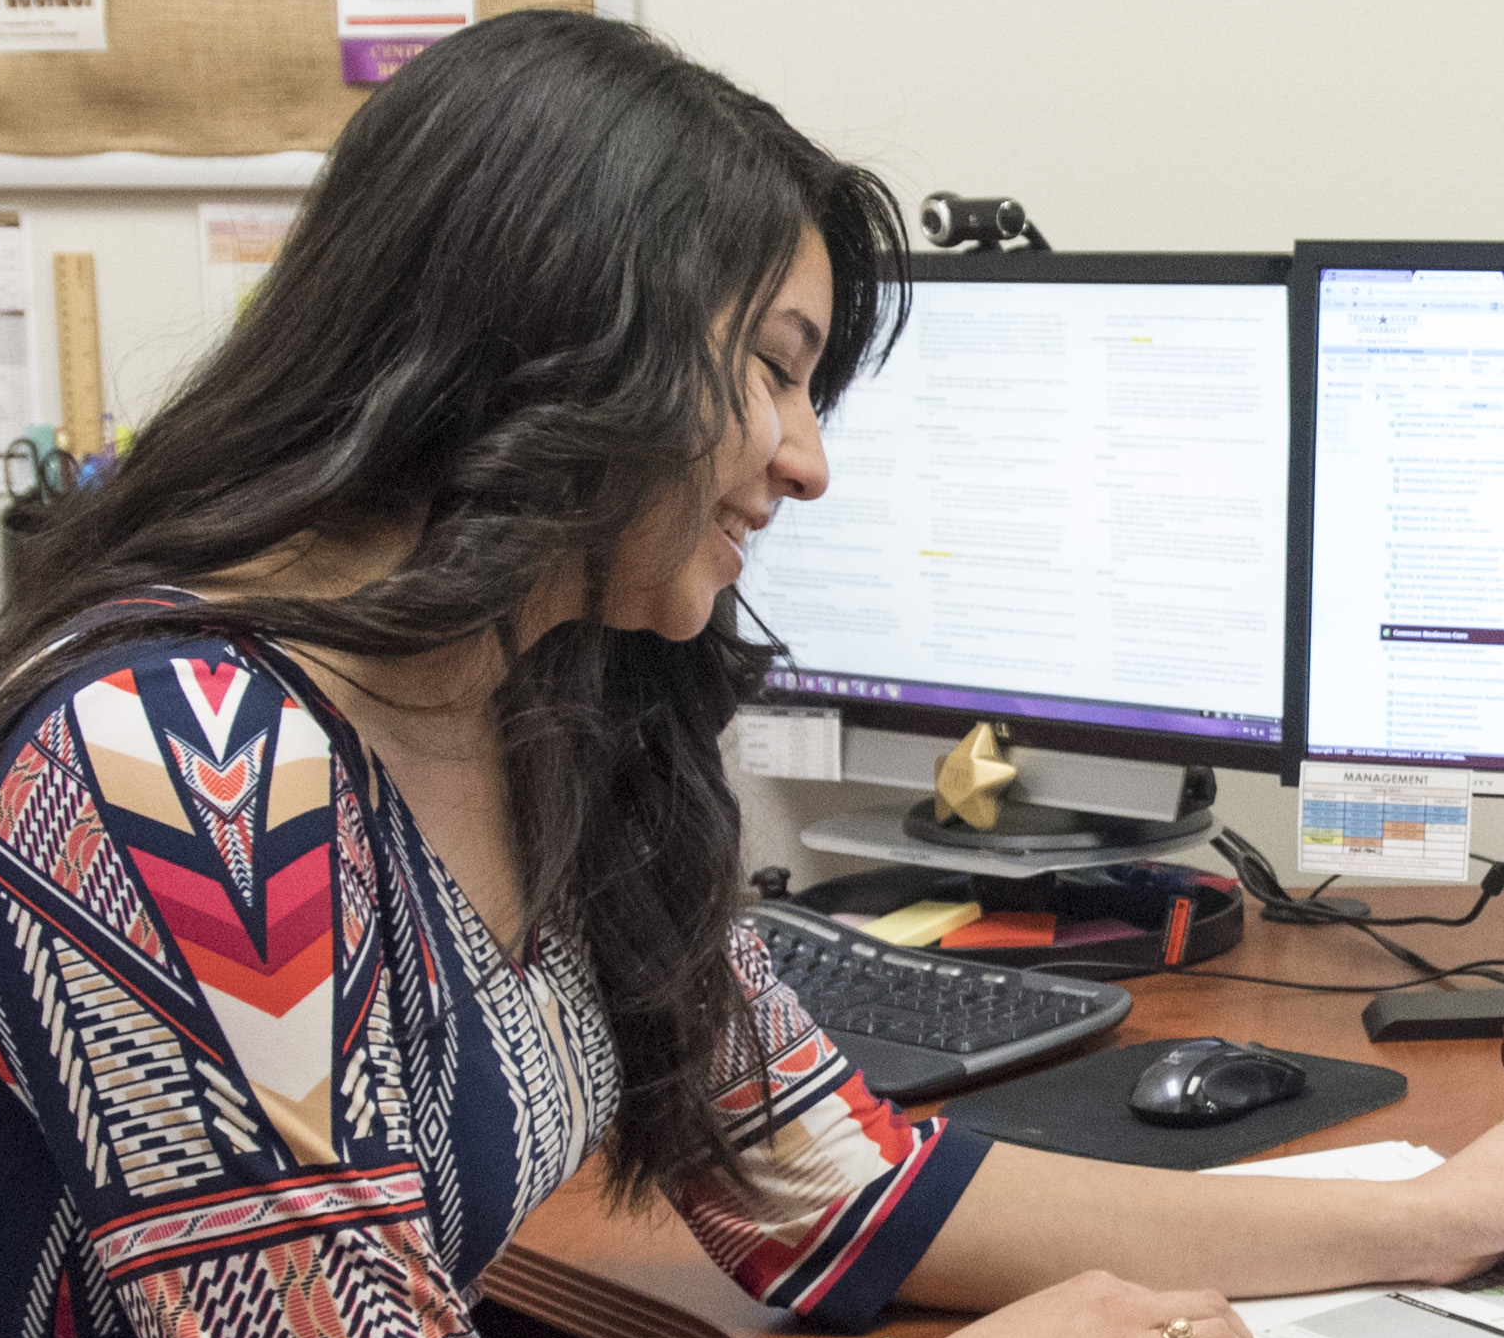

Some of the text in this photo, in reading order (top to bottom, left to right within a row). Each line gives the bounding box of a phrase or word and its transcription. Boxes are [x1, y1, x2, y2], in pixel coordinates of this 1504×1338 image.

[1348, 314, 1418, 323] TEXAS STATE
[1357, 326, 1407, 334] UNIVERSITY
[1393, 629, 1421, 637] Common
[1343, 772, 1430, 786] MANAGEMENT
